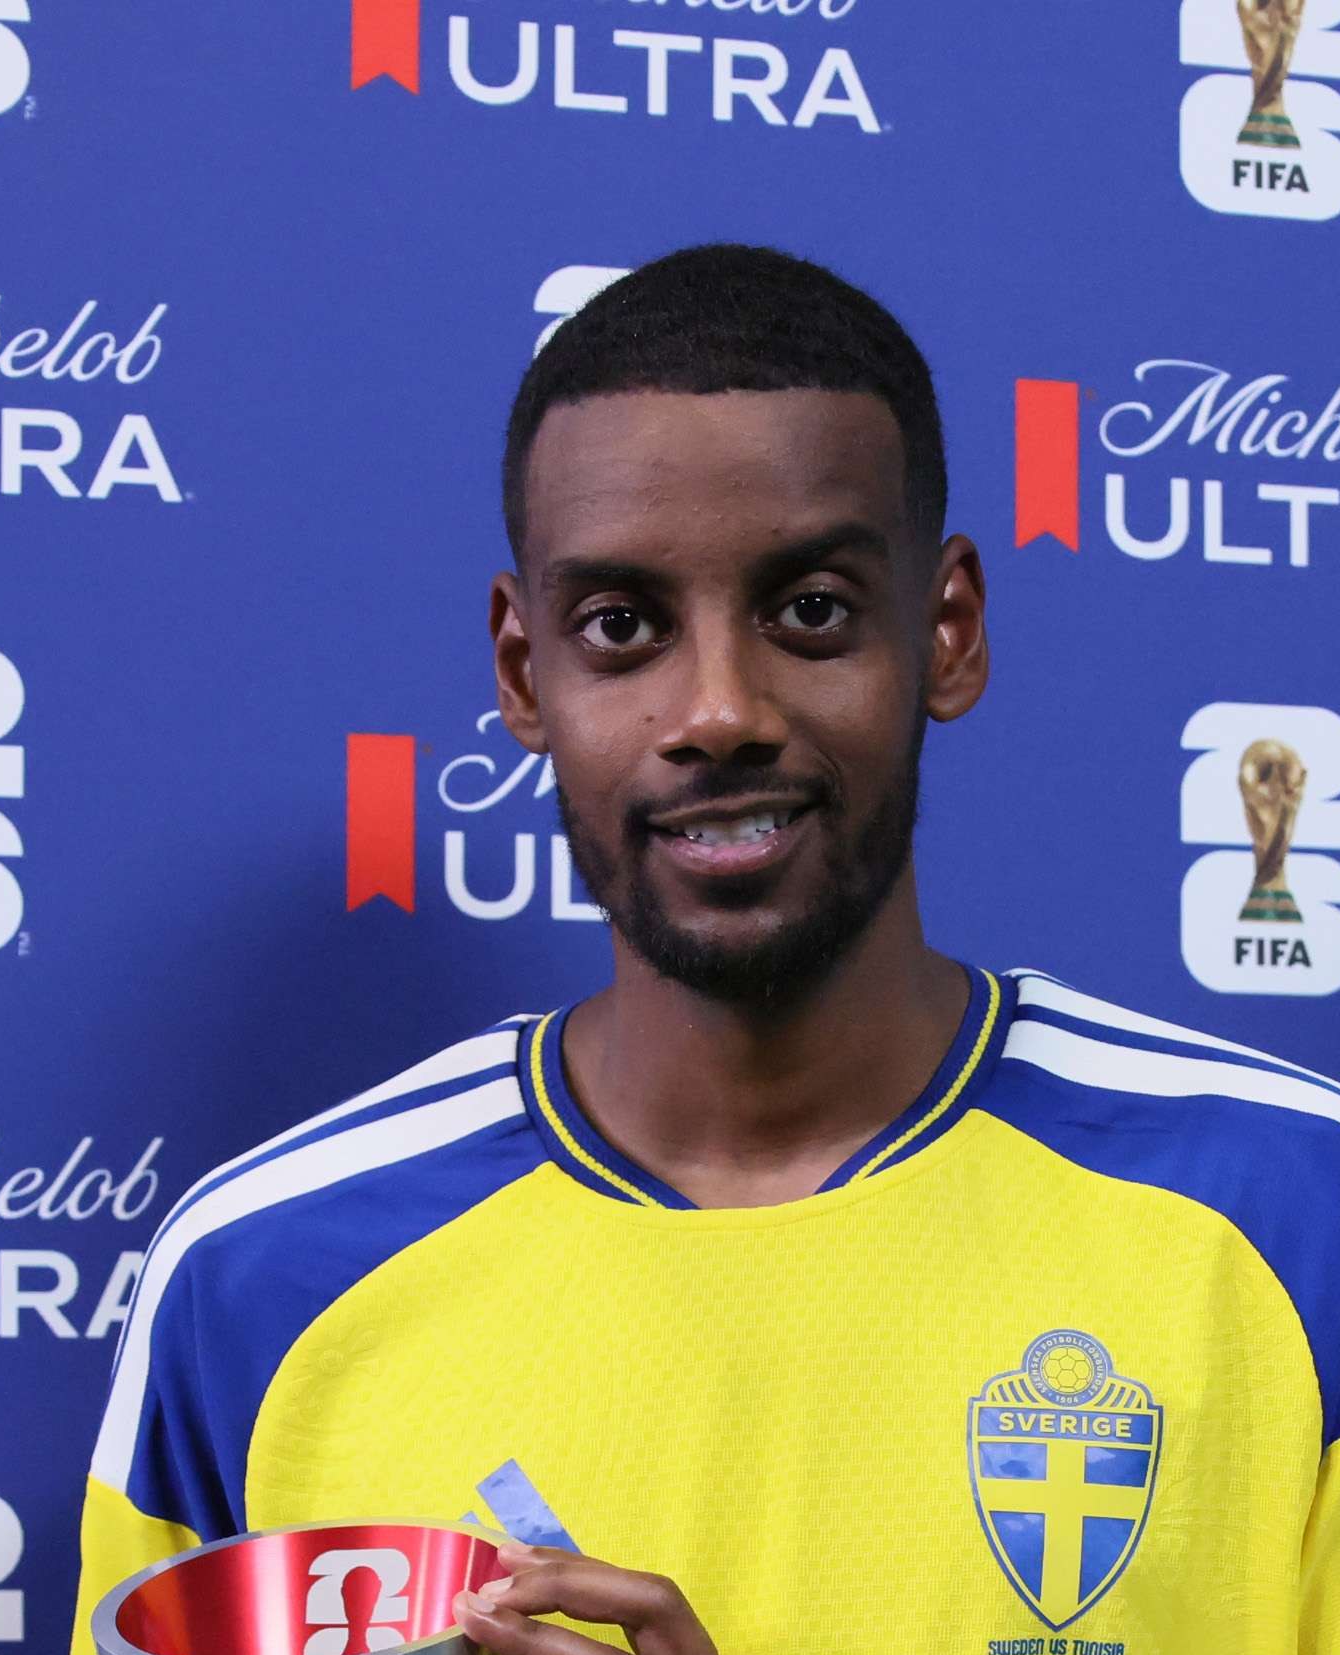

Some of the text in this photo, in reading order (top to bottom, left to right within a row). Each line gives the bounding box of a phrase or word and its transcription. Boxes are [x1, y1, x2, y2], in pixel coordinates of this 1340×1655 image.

[449, 16, 881, 133] ULTRA
[1234, 160, 1309, 192] FIFA
[1235, 938, 1311, 967] FIFA
[999, 1412, 1132, 1437] SVERIGE
